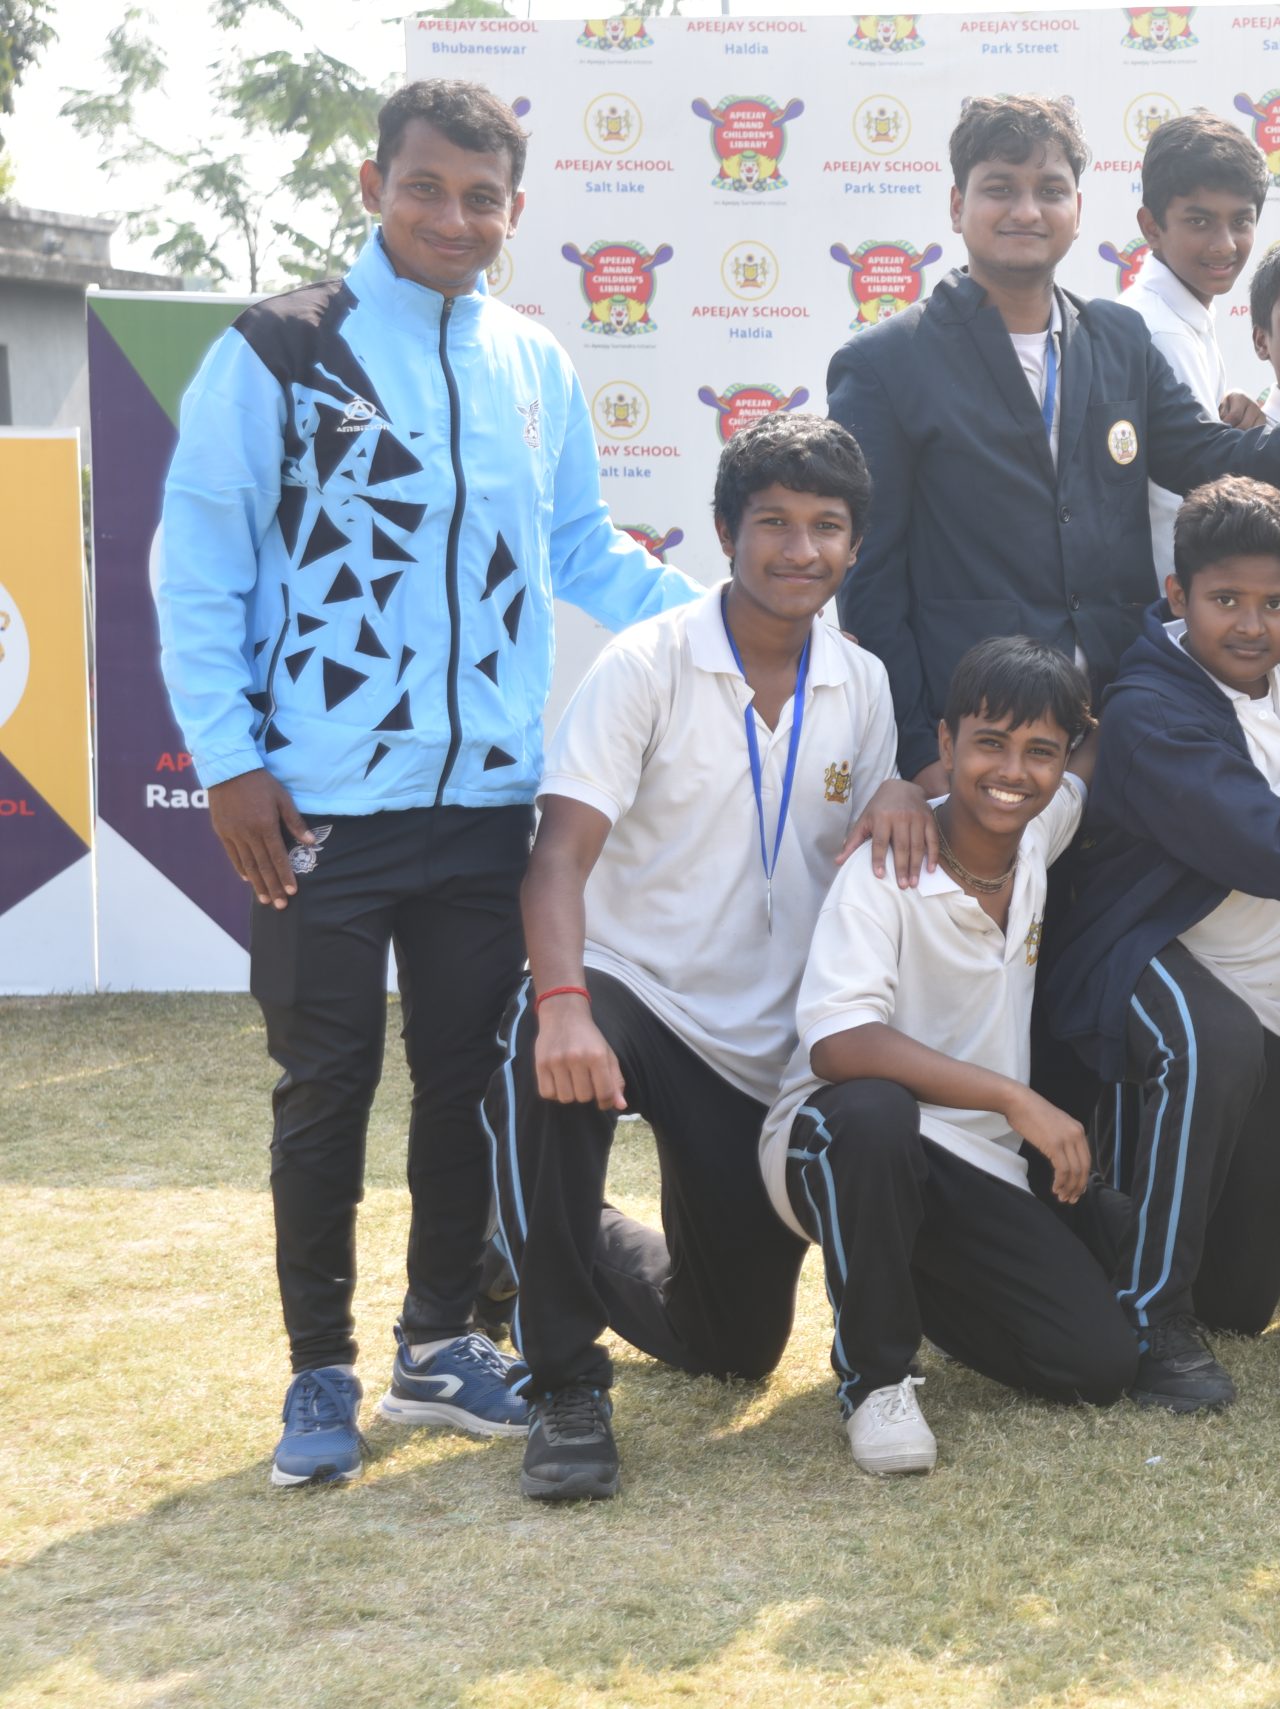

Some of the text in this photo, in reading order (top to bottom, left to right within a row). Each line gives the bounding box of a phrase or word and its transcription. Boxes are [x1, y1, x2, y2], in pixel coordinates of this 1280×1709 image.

[418, 20, 539, 33] APEEJAY SCHOOL
[687, 20, 807, 33] APEEJAY SCHOOL
[960, 19, 1080, 34] APEEJAY SCHOOL
[431, 41, 527, 56] Bhubaneswar
[724, 42, 769, 55] Haldia
[981, 42, 1059, 55] Park Street
[729, 111, 767, 120] APEEJAY
[732, 121, 764, 129] ANAND
[729, 140, 768, 149] LIBRARY
[554, 159, 674, 173] APEEJAY SCHOOL
[823, 160, 942, 174] APEEJAY SCHOOL
[1093, 160, 1142, 174] APEEJA
[585, 181, 645, 193] Salt lake
[844, 182, 922, 194] Park Street
[598, 256, 637, 265] APEEJAY
[867, 255, 905, 264] APEEJAY
[602, 265, 634, 274] ANAND
[871, 265, 902, 274] ANAND
[599, 284, 638, 294] LIBRARY
[867, 284, 906, 293] LIBRARY
[692, 305, 810, 319] APEEJAY SCHOOL
[728, 327, 773, 340] Haldia
[623, 445, 681, 458] SCHOOL
[600, 466, 652, 478] alt lake
